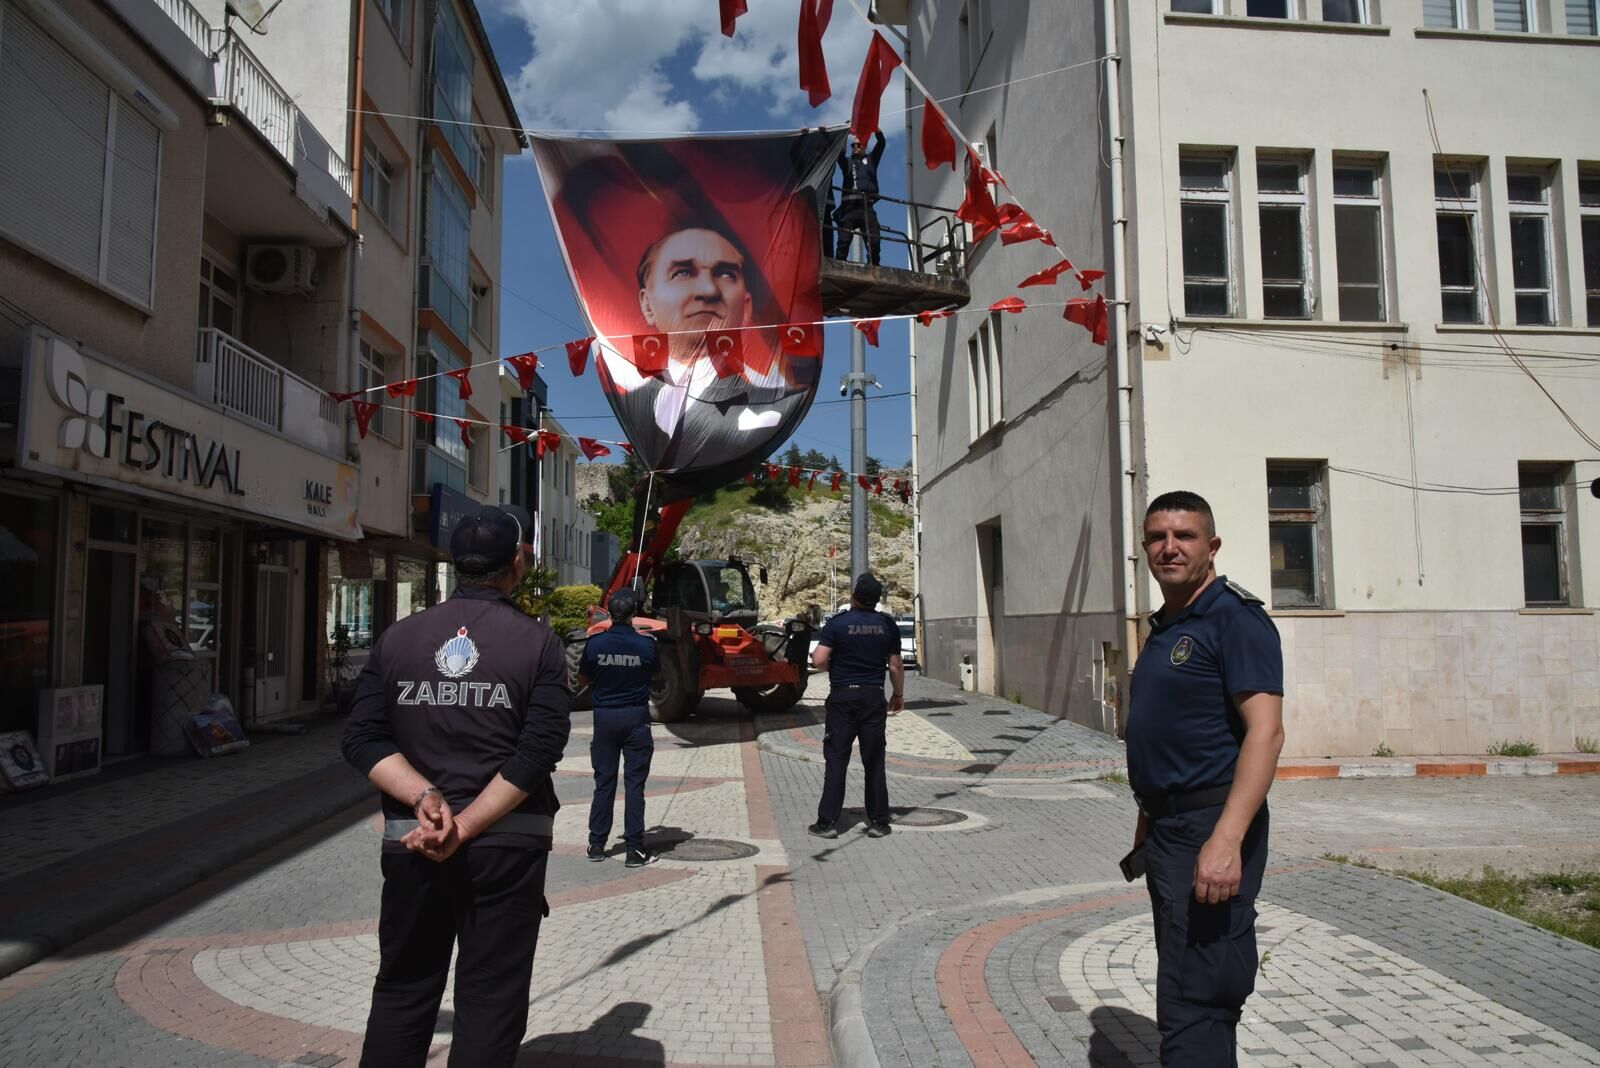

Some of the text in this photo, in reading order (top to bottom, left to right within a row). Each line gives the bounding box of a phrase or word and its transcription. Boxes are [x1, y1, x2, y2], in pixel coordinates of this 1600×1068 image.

[305, 480, 332, 504] KALE
[848, 624, 884, 635] ZABITA
[597, 654, 641, 667] ZABITA
[397, 681, 512, 709] ZABITA
